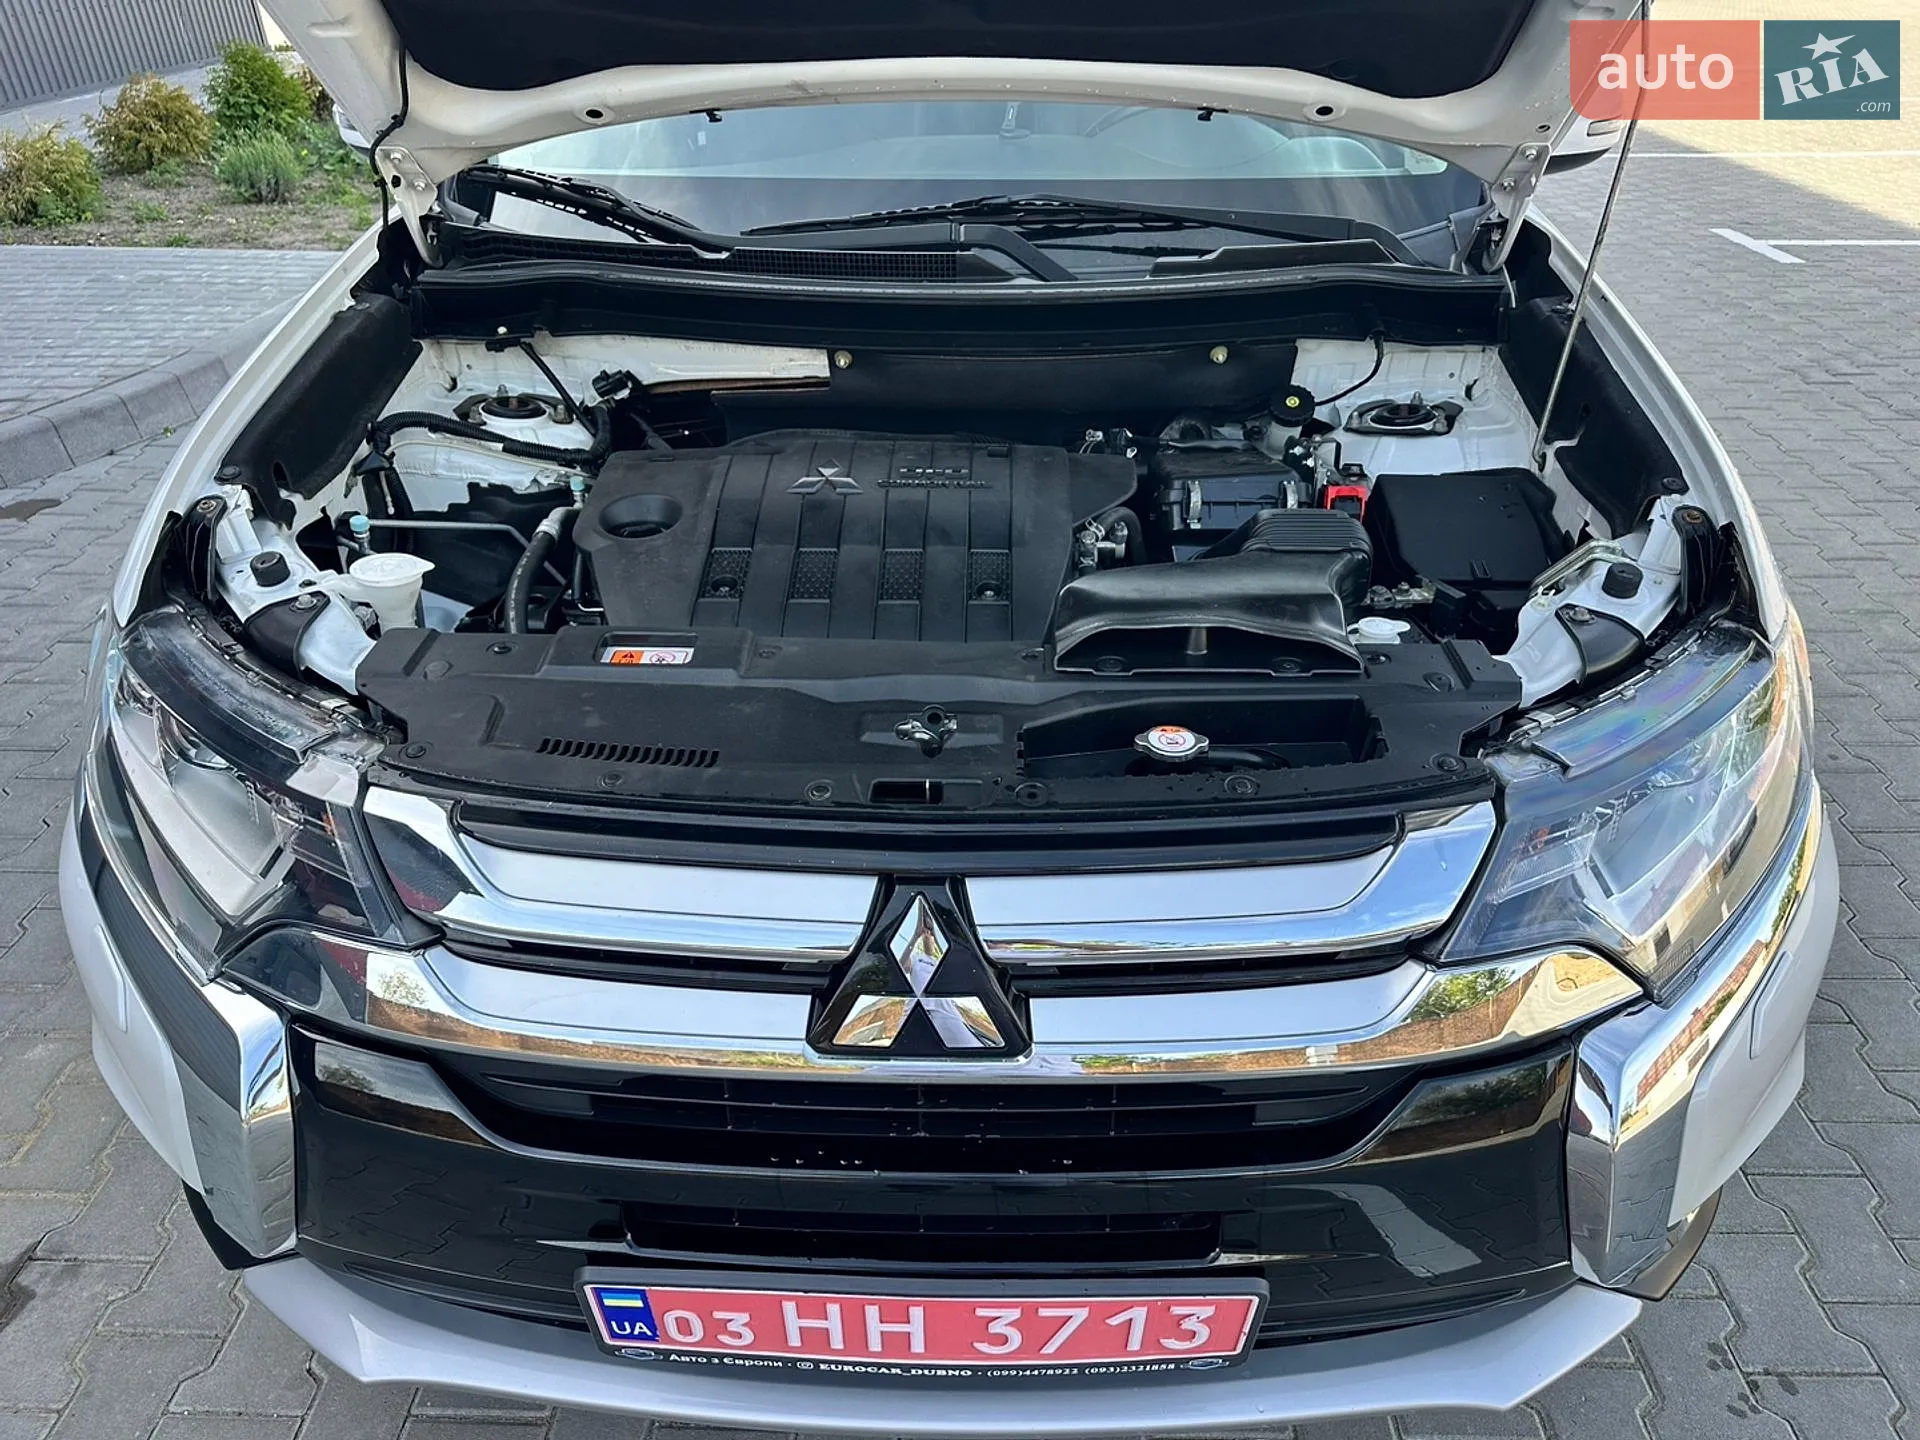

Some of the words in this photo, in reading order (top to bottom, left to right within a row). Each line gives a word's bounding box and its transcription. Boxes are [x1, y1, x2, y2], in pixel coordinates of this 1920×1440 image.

[610, 1320, 652, 1337] UA
[662, 1309, 755, 1347] 03
[783, 1300, 926, 1354] HH
[972, 1304, 1217, 1356] 3713
[669, 1353, 707, 1364] Авто
